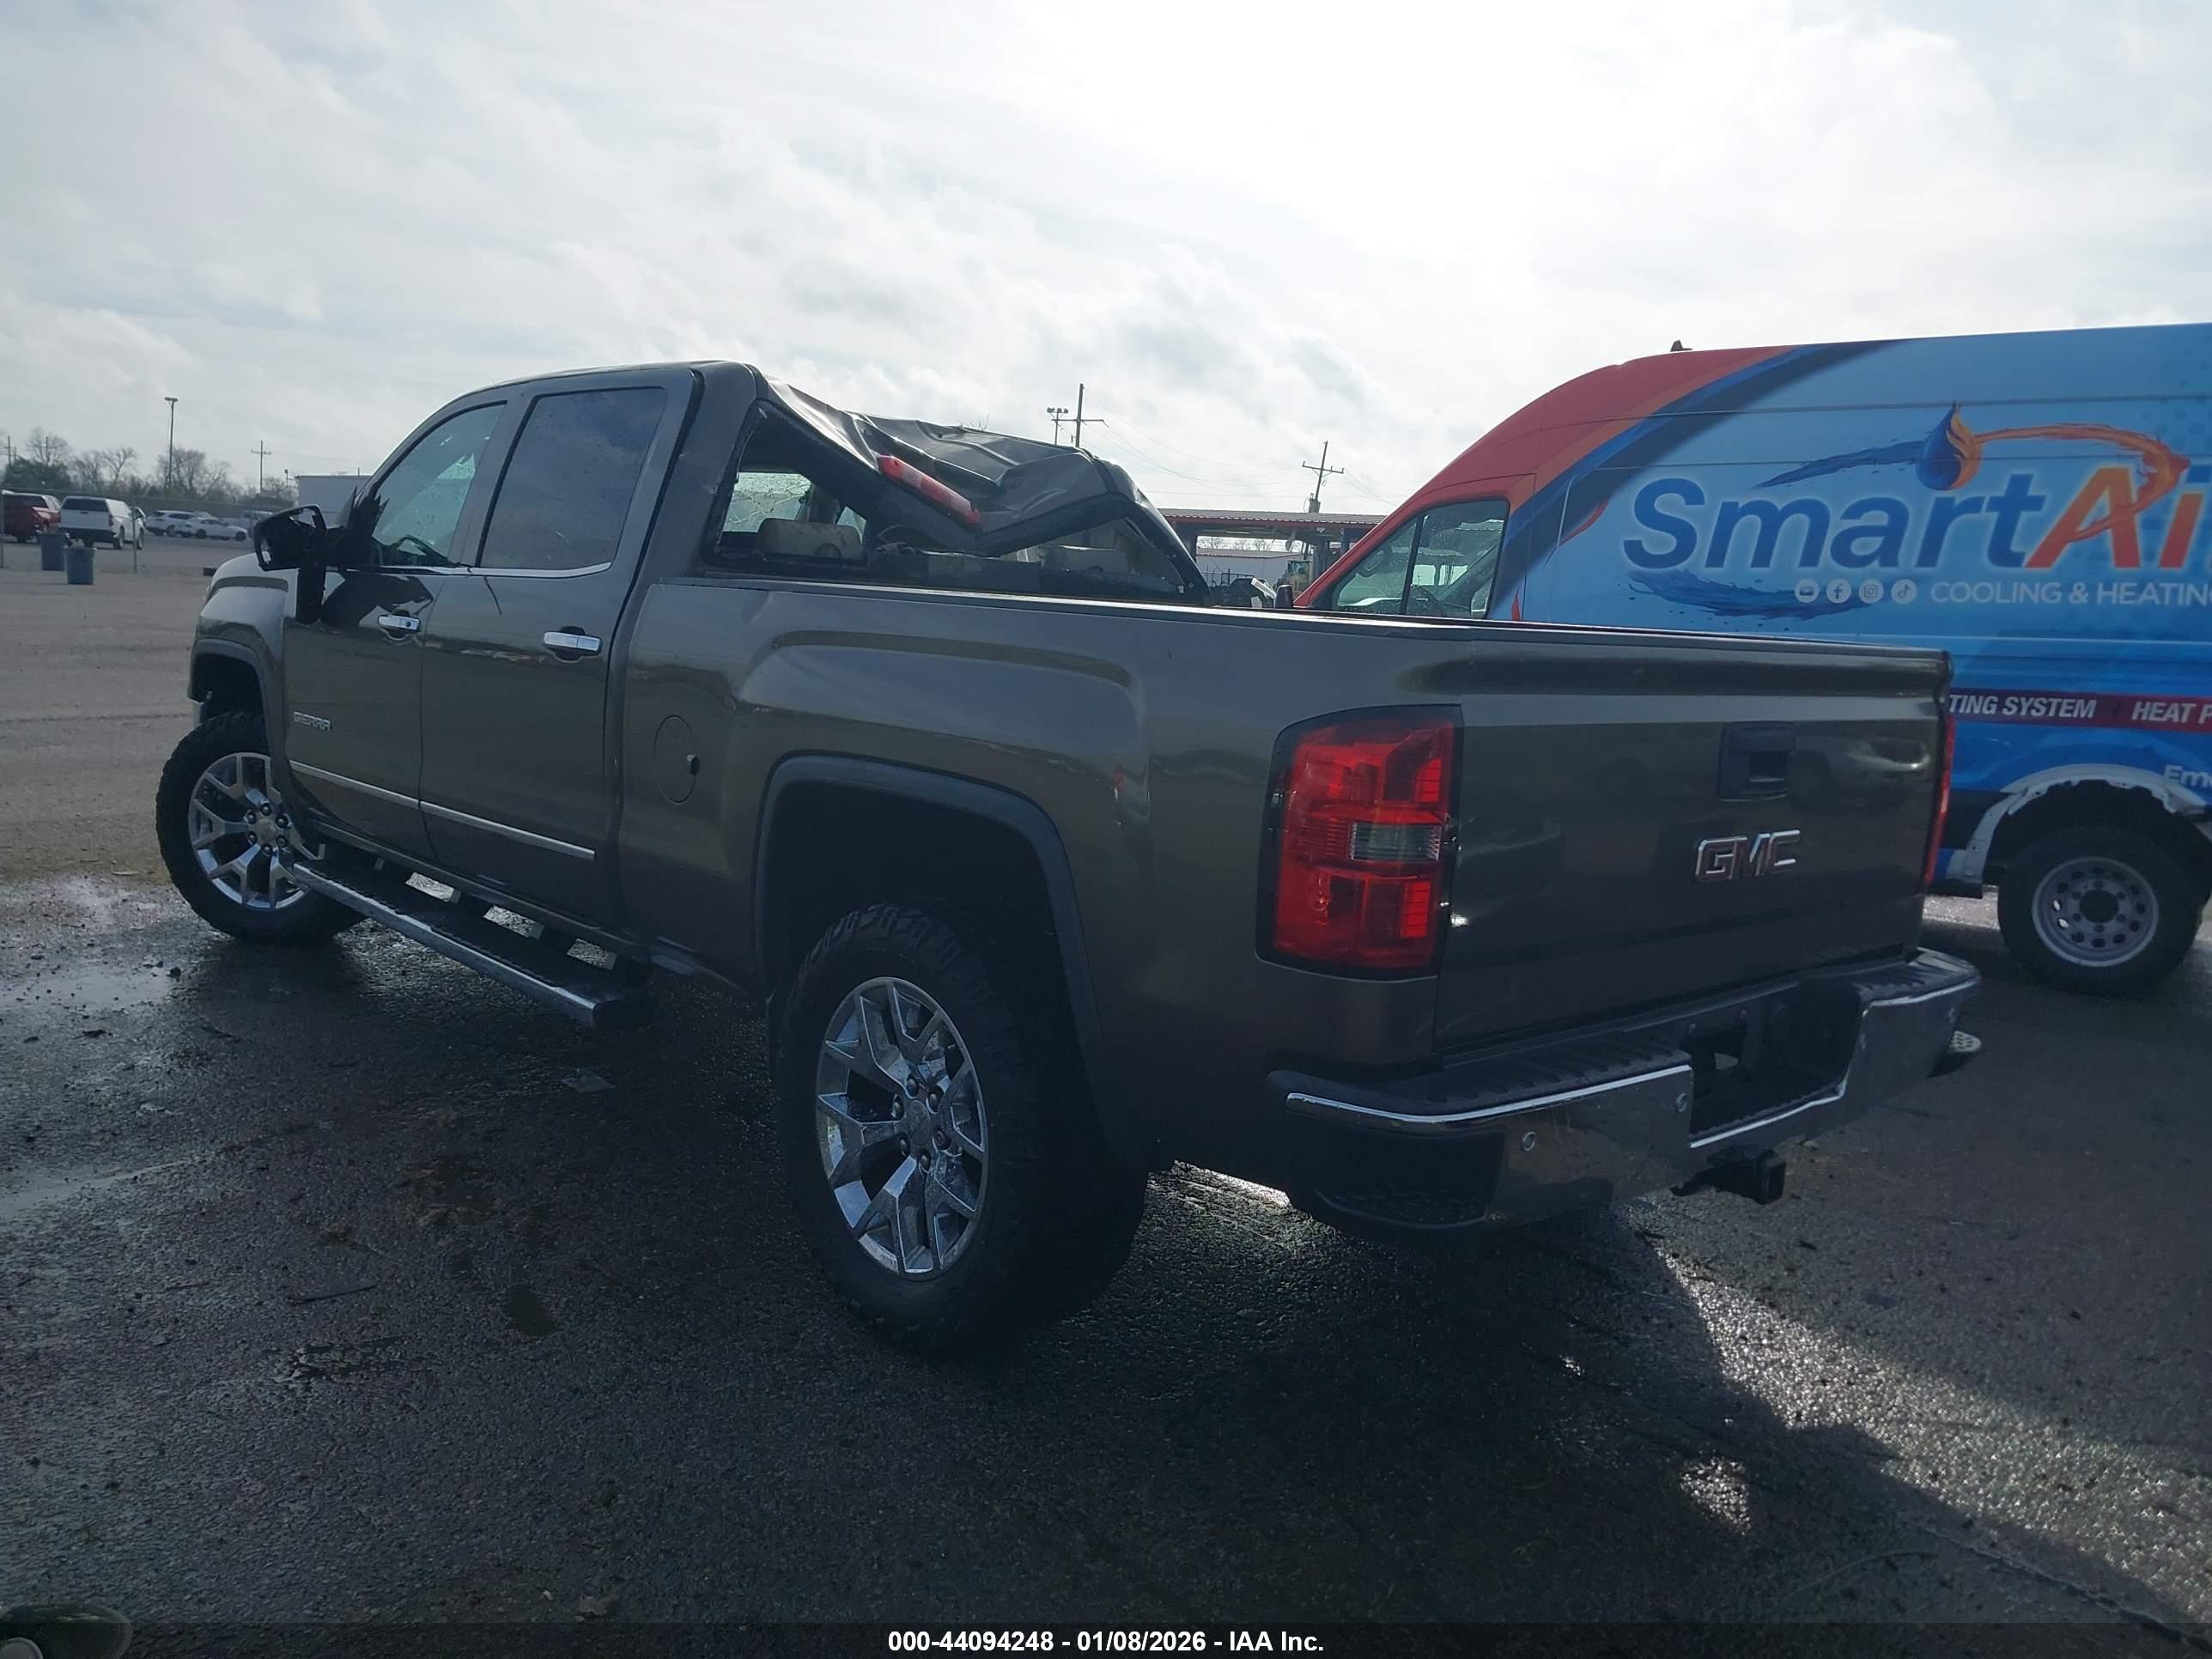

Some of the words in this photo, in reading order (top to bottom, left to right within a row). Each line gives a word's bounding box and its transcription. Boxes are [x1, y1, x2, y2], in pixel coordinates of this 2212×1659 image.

[1623, 464, 2212, 571] SmartAi
[1930, 581, 2061, 604] COOLING
[2068, 582, 2088, 605] &
[2096, 582, 2212, 607] HEATIN
[1949, 694, 1998, 715] TING
[2002, 696, 2097, 719] SYSTEM
[2131, 701, 2197, 723] HEAT
[2164, 764, 2212, 788] Em
[1695, 830, 1801, 881] GMC
